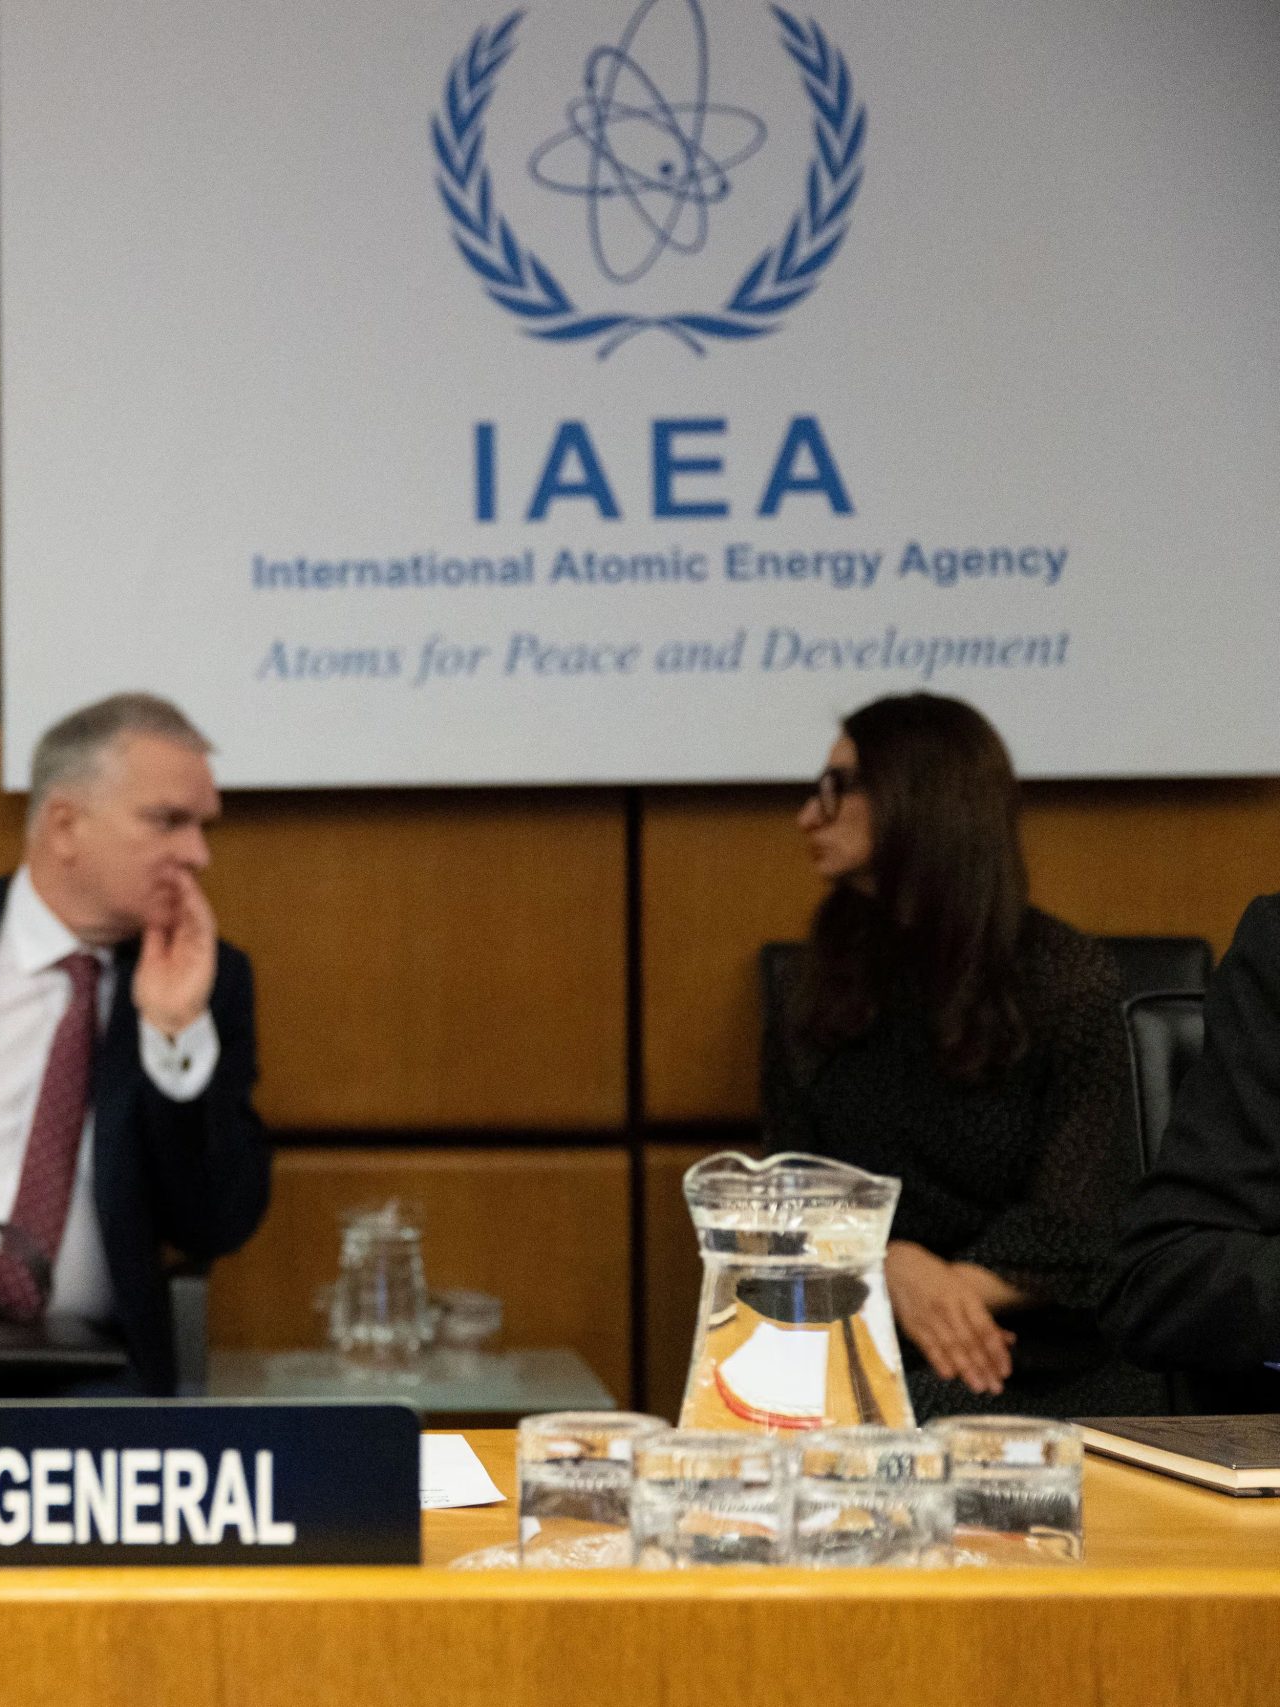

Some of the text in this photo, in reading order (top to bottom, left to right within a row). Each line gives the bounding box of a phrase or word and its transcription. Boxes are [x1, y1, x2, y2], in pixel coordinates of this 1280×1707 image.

[474, 413, 854, 524] IAEA
[252, 540, 1068, 590] International Atomic Energy Agency
[260, 627, 1070, 686] Atoms for Peace and Development
